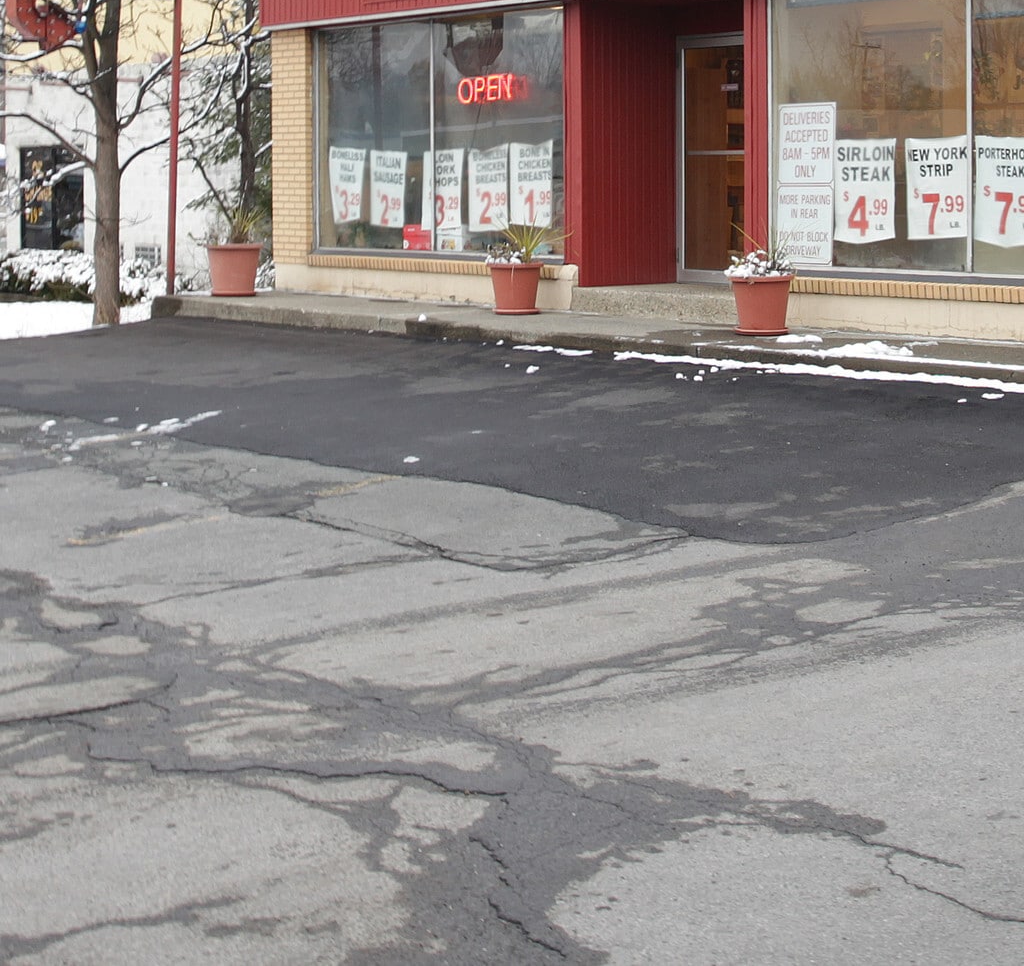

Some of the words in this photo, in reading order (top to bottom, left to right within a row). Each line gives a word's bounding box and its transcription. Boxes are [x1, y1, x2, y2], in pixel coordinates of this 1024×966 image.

[457, 73, 513, 105] OPEN
[783, 111, 830, 126] DELIVERIES
[785, 129, 829, 142] ACCEPTED
[435, 153, 454, 163] OIN
[783, 147, 802, 161] 8AM
[811, 147, 830, 160] 5PM
[837, 145, 895, 161] SIRLOIN
[908, 149, 930, 162] NEW
[934, 146, 968, 160] YORK
[376, 155, 401, 169] ITALIAN
[476, 162, 505, 173] CHICKEN
[518, 159, 551, 170] CHICKEN
[436, 165, 455, 175] ORK
[518, 170, 552, 182] BREASTS
[795, 165, 816, 178] ONLY
[842, 166, 891, 182] STEAK
[920, 163, 953, 177] STRIP
[996, 165, 1024, 178] STEAK
[374, 171, 404, 185] SAUSAGE
[780, 194, 798, 205] MORE
[801, 194, 831, 205] PARKING
[791, 208, 798, 218] IN
[800, 208, 818, 219] REAR
[807, 231, 829, 242] BLOCK
